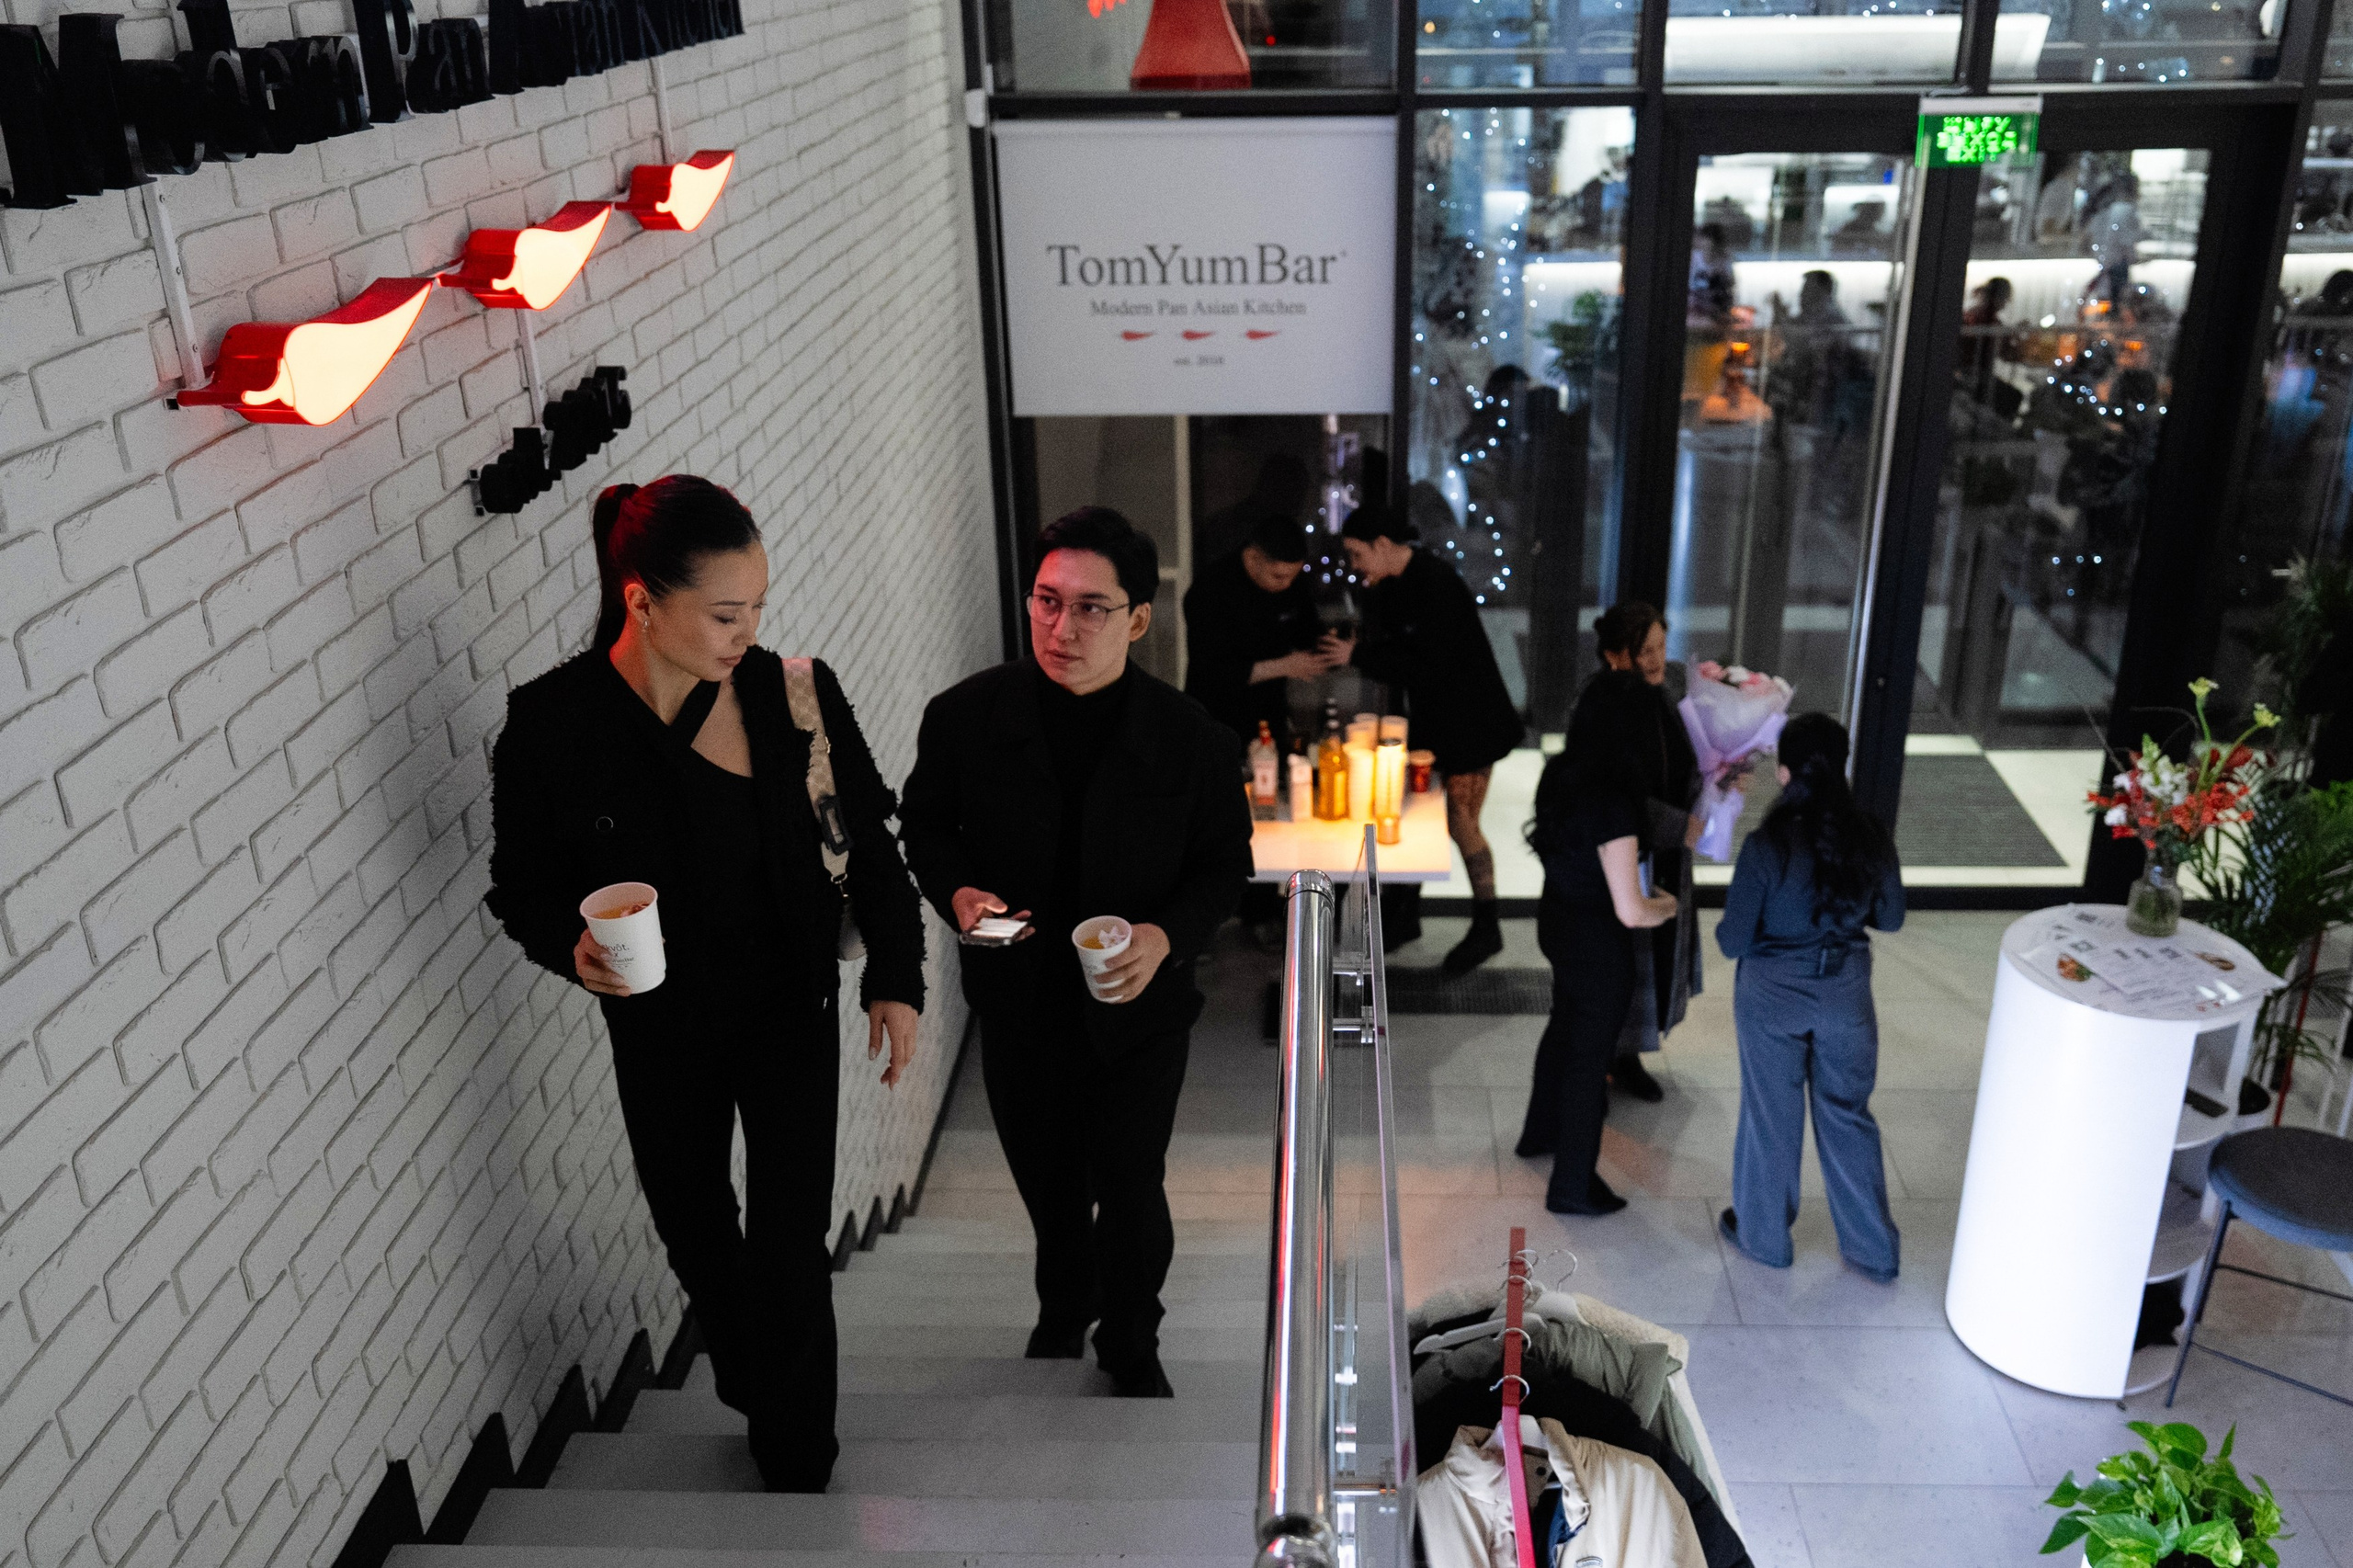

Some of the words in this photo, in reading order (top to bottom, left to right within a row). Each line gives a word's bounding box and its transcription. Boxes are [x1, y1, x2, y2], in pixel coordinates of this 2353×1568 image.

[1946, 145, 2002, 163] EXIT
[1091, 300, 1153, 316] Modern
[1158, 300, 1188, 316] Pan
[1194, 300, 1239, 315] Asian
[1244, 299, 1306, 315] Kitchen
